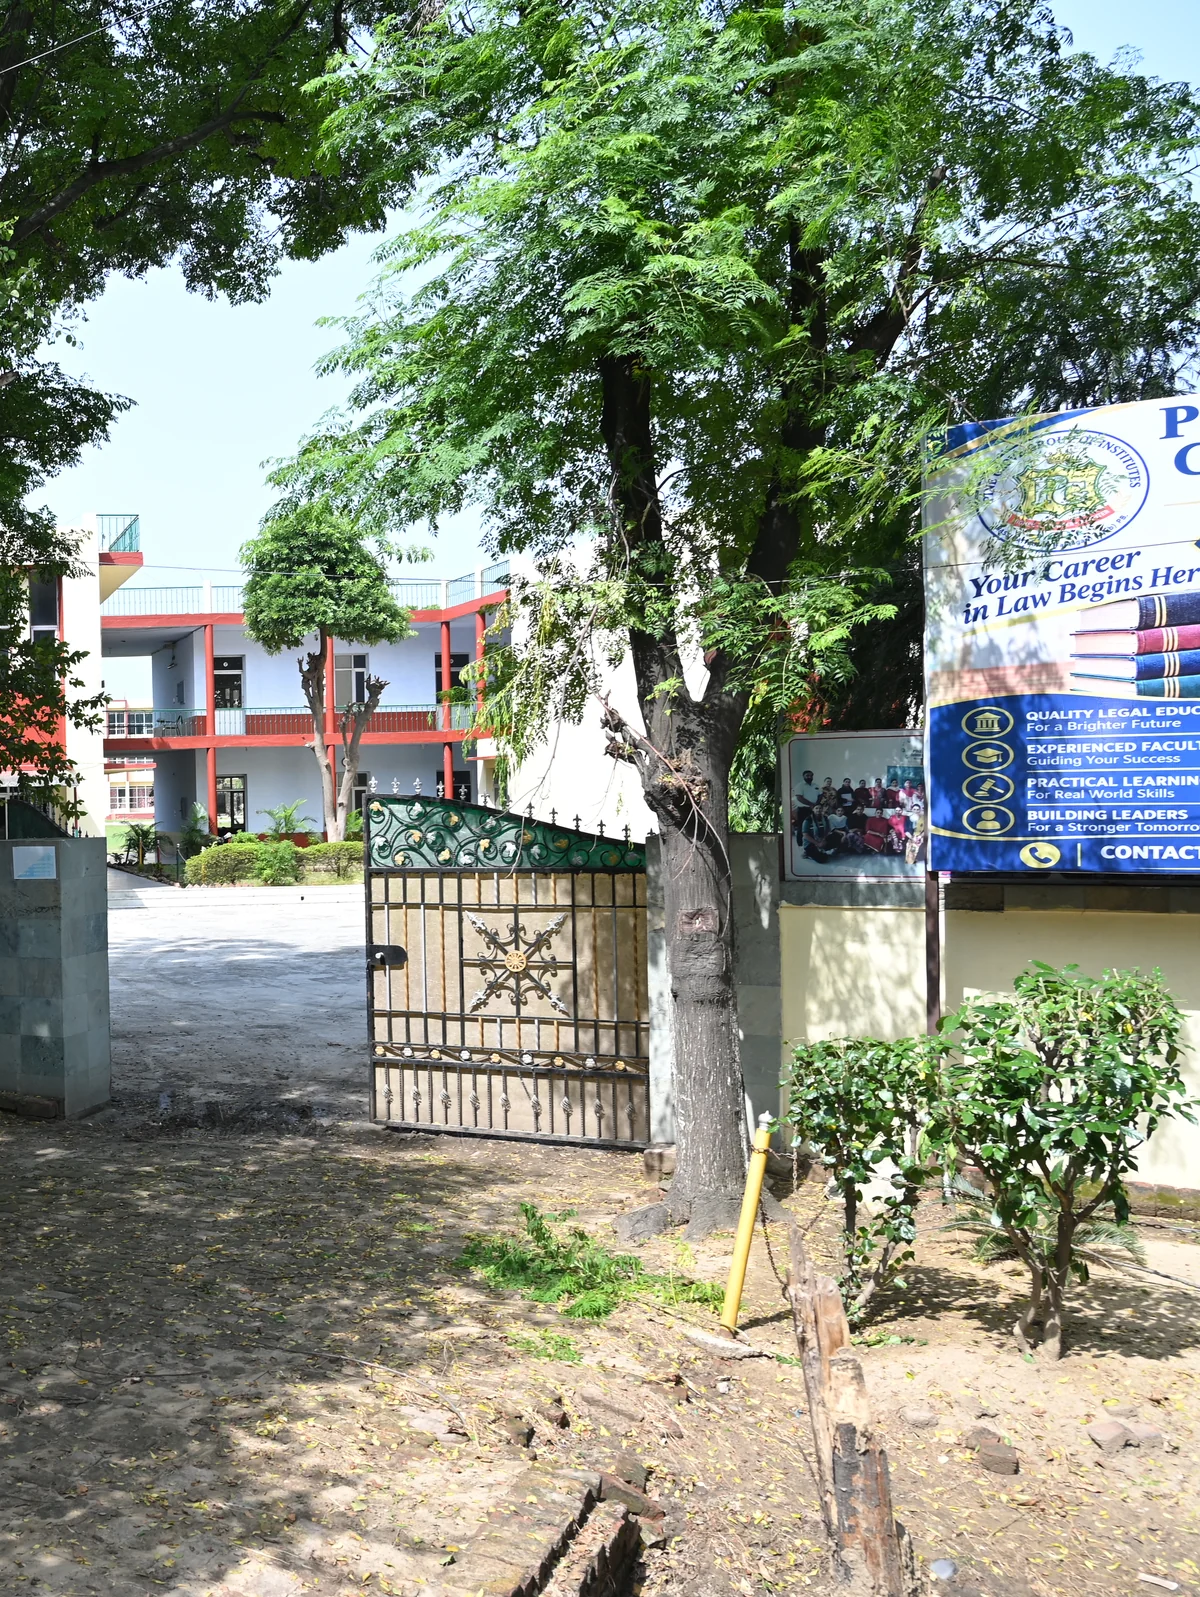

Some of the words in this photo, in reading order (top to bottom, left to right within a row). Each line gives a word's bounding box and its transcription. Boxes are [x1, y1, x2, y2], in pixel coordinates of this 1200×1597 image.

[1158, 405, 1200, 440] P
[1098, 440, 1141, 488] INSTITUTES
[969, 569, 1036, 599] Your
[1044, 551, 1142, 582] Career
[963, 603, 988, 625] in
[996, 590, 1052, 617] Law
[1058, 575, 1143, 605] Begins
[1150, 565, 1200, 587] Her
[1026, 709, 1094, 722] QUALITY
[1098, 707, 1151, 719] LEGAL
[1155, 705, 1200, 717] EDUC
[1026, 722, 1050, 732] For
[1067, 720, 1127, 732] Brighter
[1131, 719, 1182, 729] Future
[1027, 742, 1137, 754] EXPERIENCED
[1027, 755, 1082, 767] Guiding
[1085, 754, 1119, 764] Your
[1123, 754, 1181, 764] Success
[1026, 777, 1118, 788] PRACTICAL
[1123, 775, 1200, 787] LEARNIN
[1027, 790, 1051, 800] For
[1054, 790, 1085, 799] Real
[1089, 788, 1133, 799] World
[1137, 788, 1175, 799] Skills
[1027, 810, 1107, 821] BUILDING
[1112, 809, 1189, 820] LEADERS
[1027, 823, 1051, 832] For
[1055, 824, 1064, 832] a
[1068, 822, 1131, 834] Stronger
